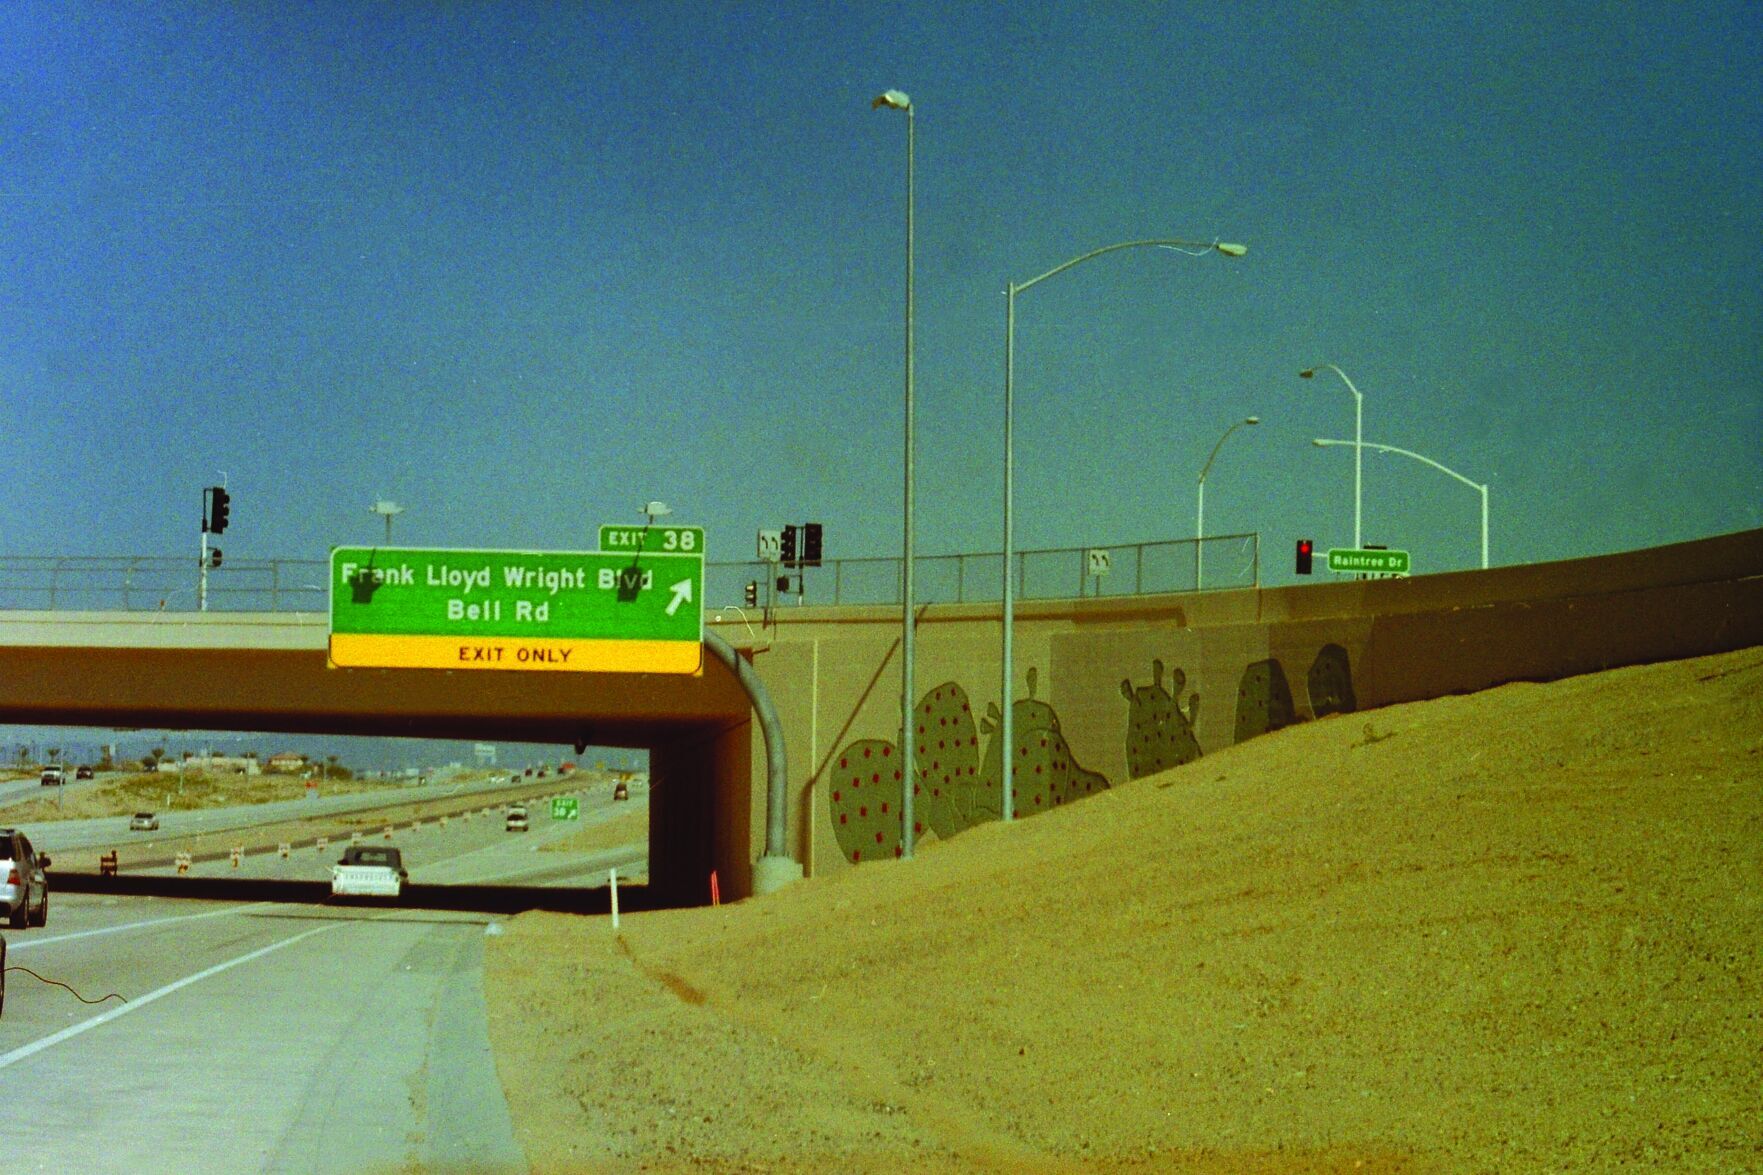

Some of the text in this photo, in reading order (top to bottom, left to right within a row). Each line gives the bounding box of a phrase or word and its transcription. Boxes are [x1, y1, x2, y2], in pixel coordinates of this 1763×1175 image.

[609, 530, 695, 550] EXIT 38
[1334, 555, 1402, 567] Raintree Dr
[341, 562, 653, 595] Frank Lloyd Wright Blvd
[447, 599, 549, 622] Bell Rd
[459, 647, 572, 662] EXIT ONLY
